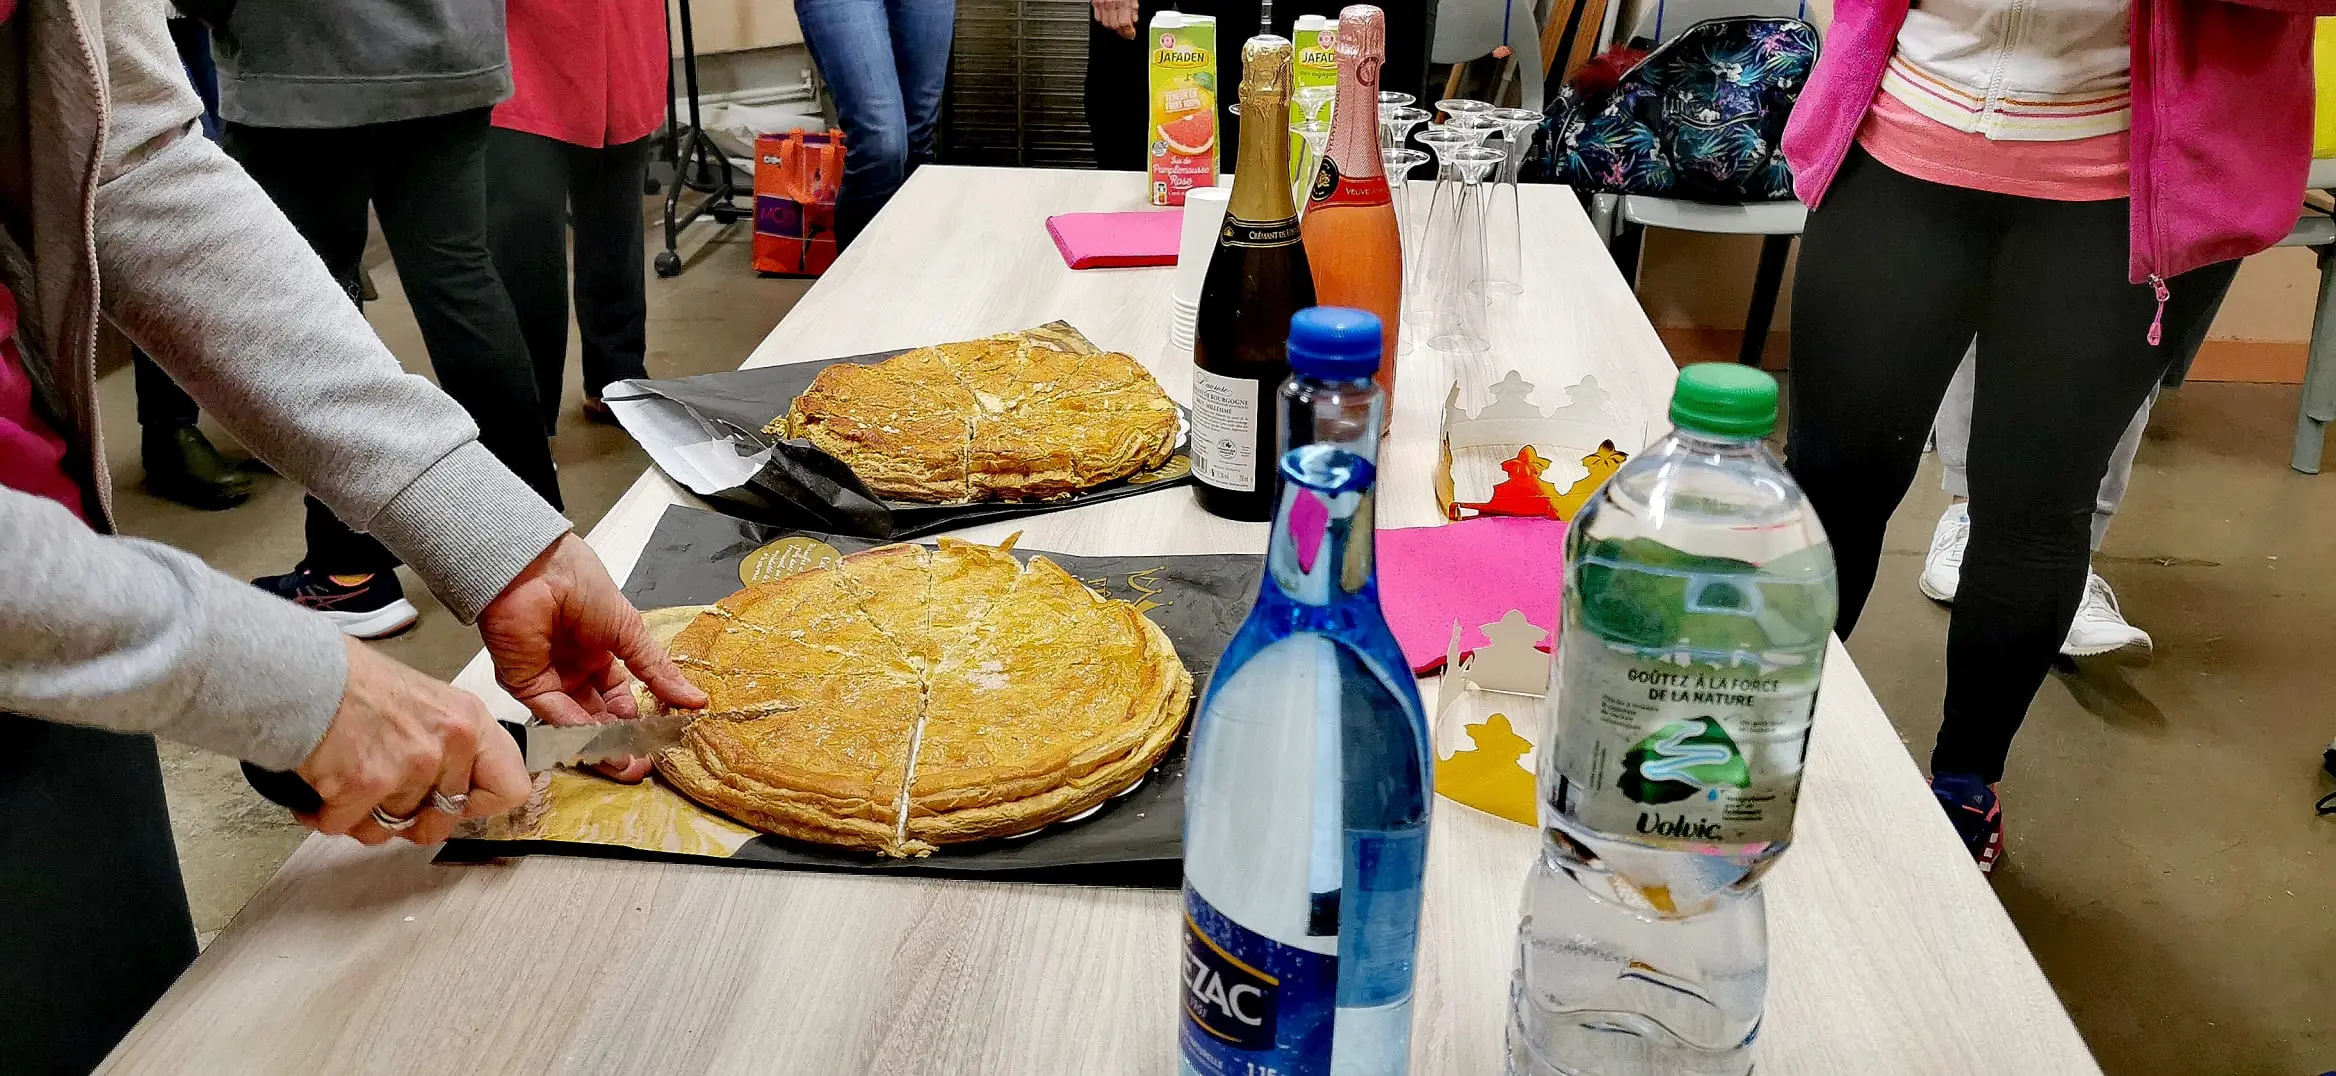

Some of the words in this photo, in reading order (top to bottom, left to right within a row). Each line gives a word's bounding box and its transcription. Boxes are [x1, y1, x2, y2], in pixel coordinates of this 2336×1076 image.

[1158, 51, 1205, 64] JAFADEN
[1302, 52, 1335, 63] JAFAD
[1153, 163, 1209, 175] Pamplemousse
[1170, 174, 1192, 186] Rose
[1345, 187, 1370, 196] VEUVE
[1210, 392, 1249, 406] BOURGOGNE
[1628, 668, 1689, 688] GOÛTEZ
[1710, 677, 1727, 690] LA
[1732, 678, 1780, 693] FORCE
[1649, 688, 1667, 702] DE
[1672, 690, 1689, 703] LA
[1694, 691, 1755, 707] NATURE
[1636, 812, 1723, 841] Volvic
